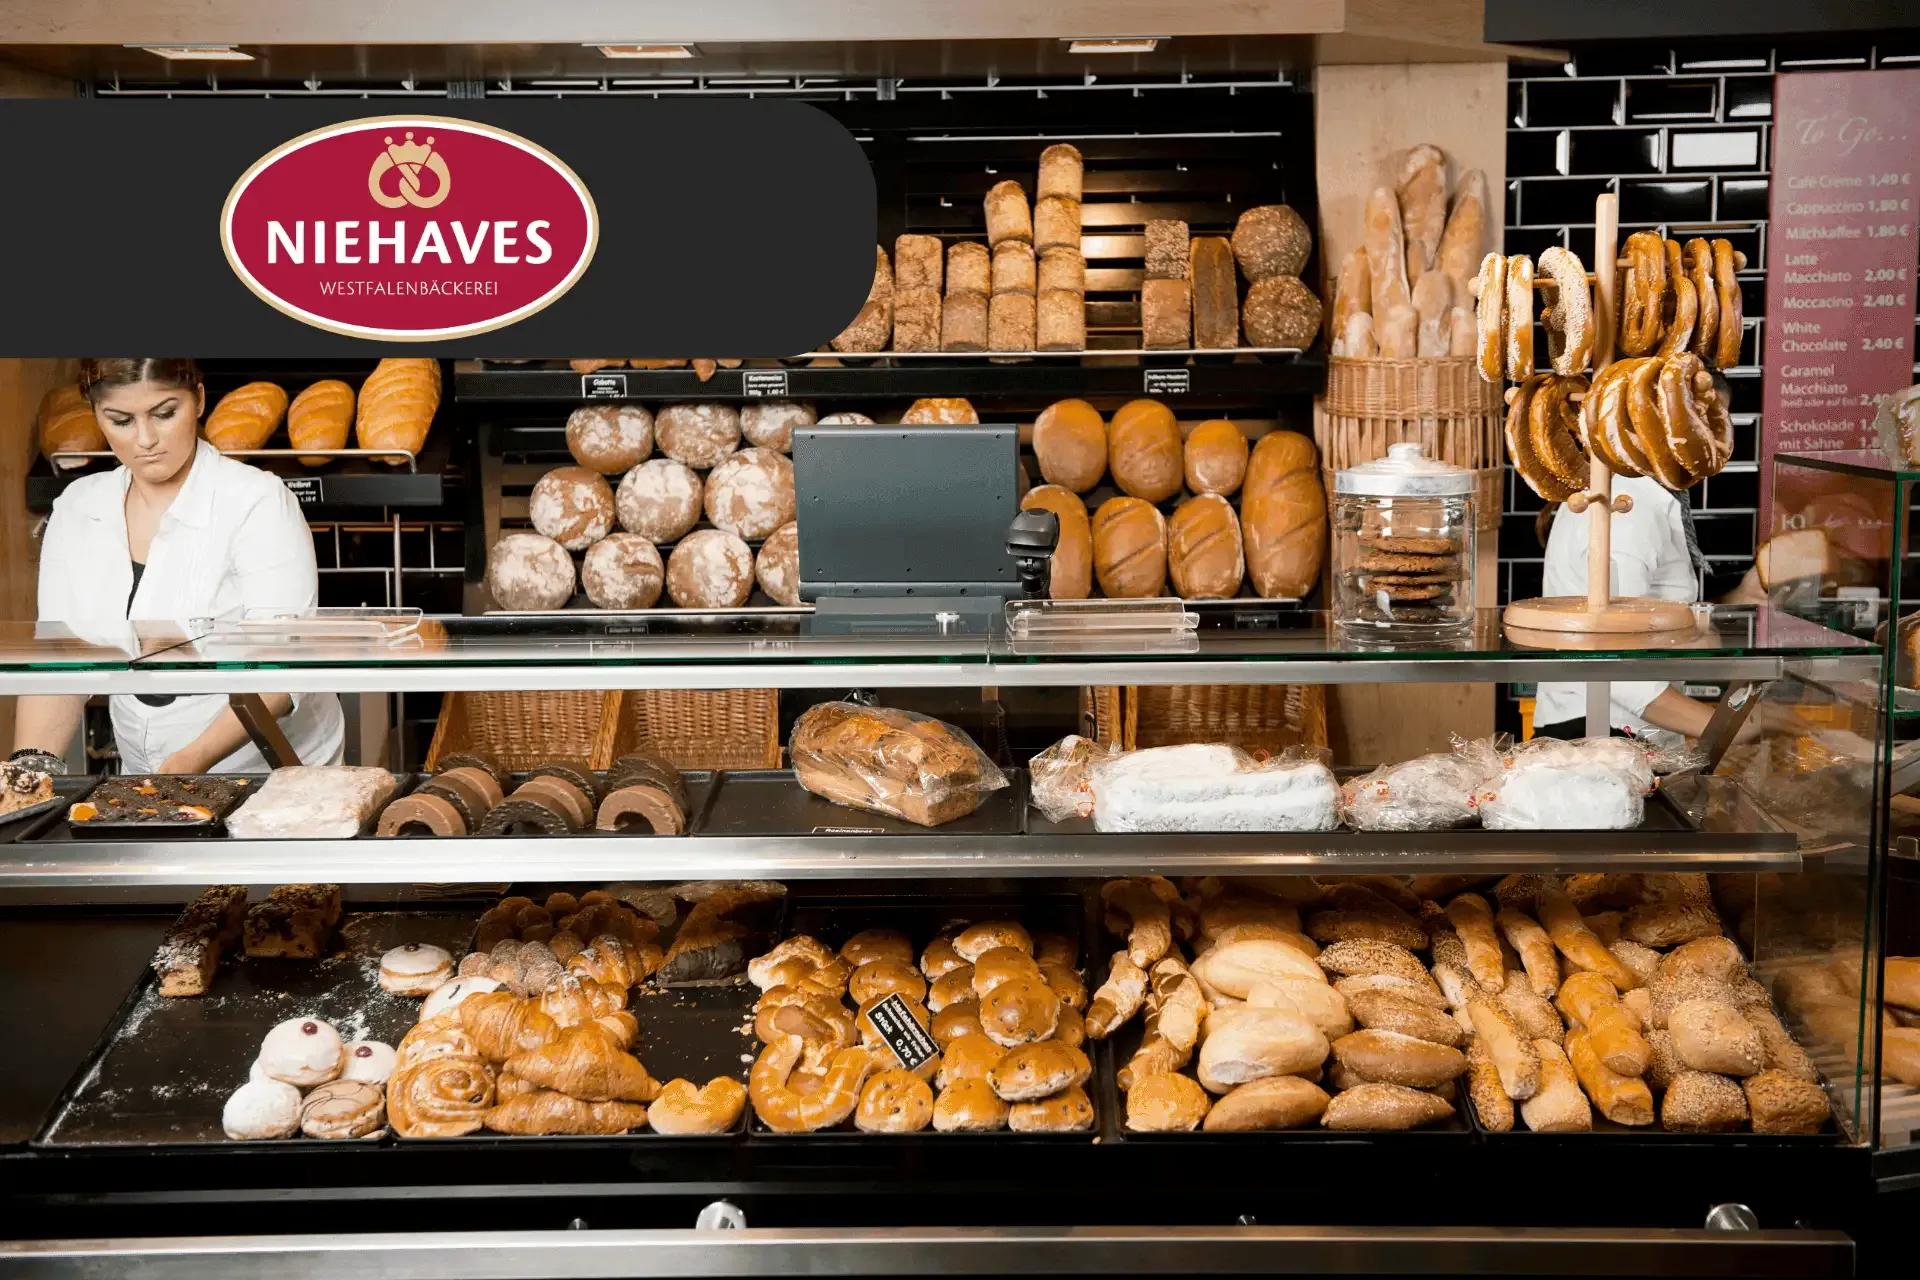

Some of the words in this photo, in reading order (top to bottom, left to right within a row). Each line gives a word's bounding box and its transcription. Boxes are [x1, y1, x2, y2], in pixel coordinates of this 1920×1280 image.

[1796, 116, 1826, 145] To
[1869, 174, 1899, 186] 1,49
[1902, 173, 1911, 184] €
[1787, 201, 1864, 215] Cappuccino
[1901, 199, 1909, 210] €
[1786, 226, 1862, 239] Milchkaffee
[1899, 225, 1909, 236] €
[1785, 254, 1819, 265] Latte
[1784, 271, 1852, 284] Macchiato
[1864, 270, 1895, 281] 2,00
[1897, 269, 1907, 280] €
[1783, 296, 1853, 308] Moccacino
[1863, 294, 1894, 307] 2,40
[1896, 294, 1906, 305] €
[1782, 322, 1821, 334] White
[1781, 339, 1848, 352] Chocolate
[1861, 338, 1892, 350] 2,40
[1894, 337, 1904, 349] €
[1780, 364, 1834, 377] Caramel
[1780, 383, 1848, 395] Macchiato
[1780, 419, 1855, 432] Schokolade
[1779, 438, 1800, 449] mit
[1803, 437, 1845, 449] Sahne
[875, 1012, 892, 1034] Stück
[896, 1039, 911, 1058] 0,70
